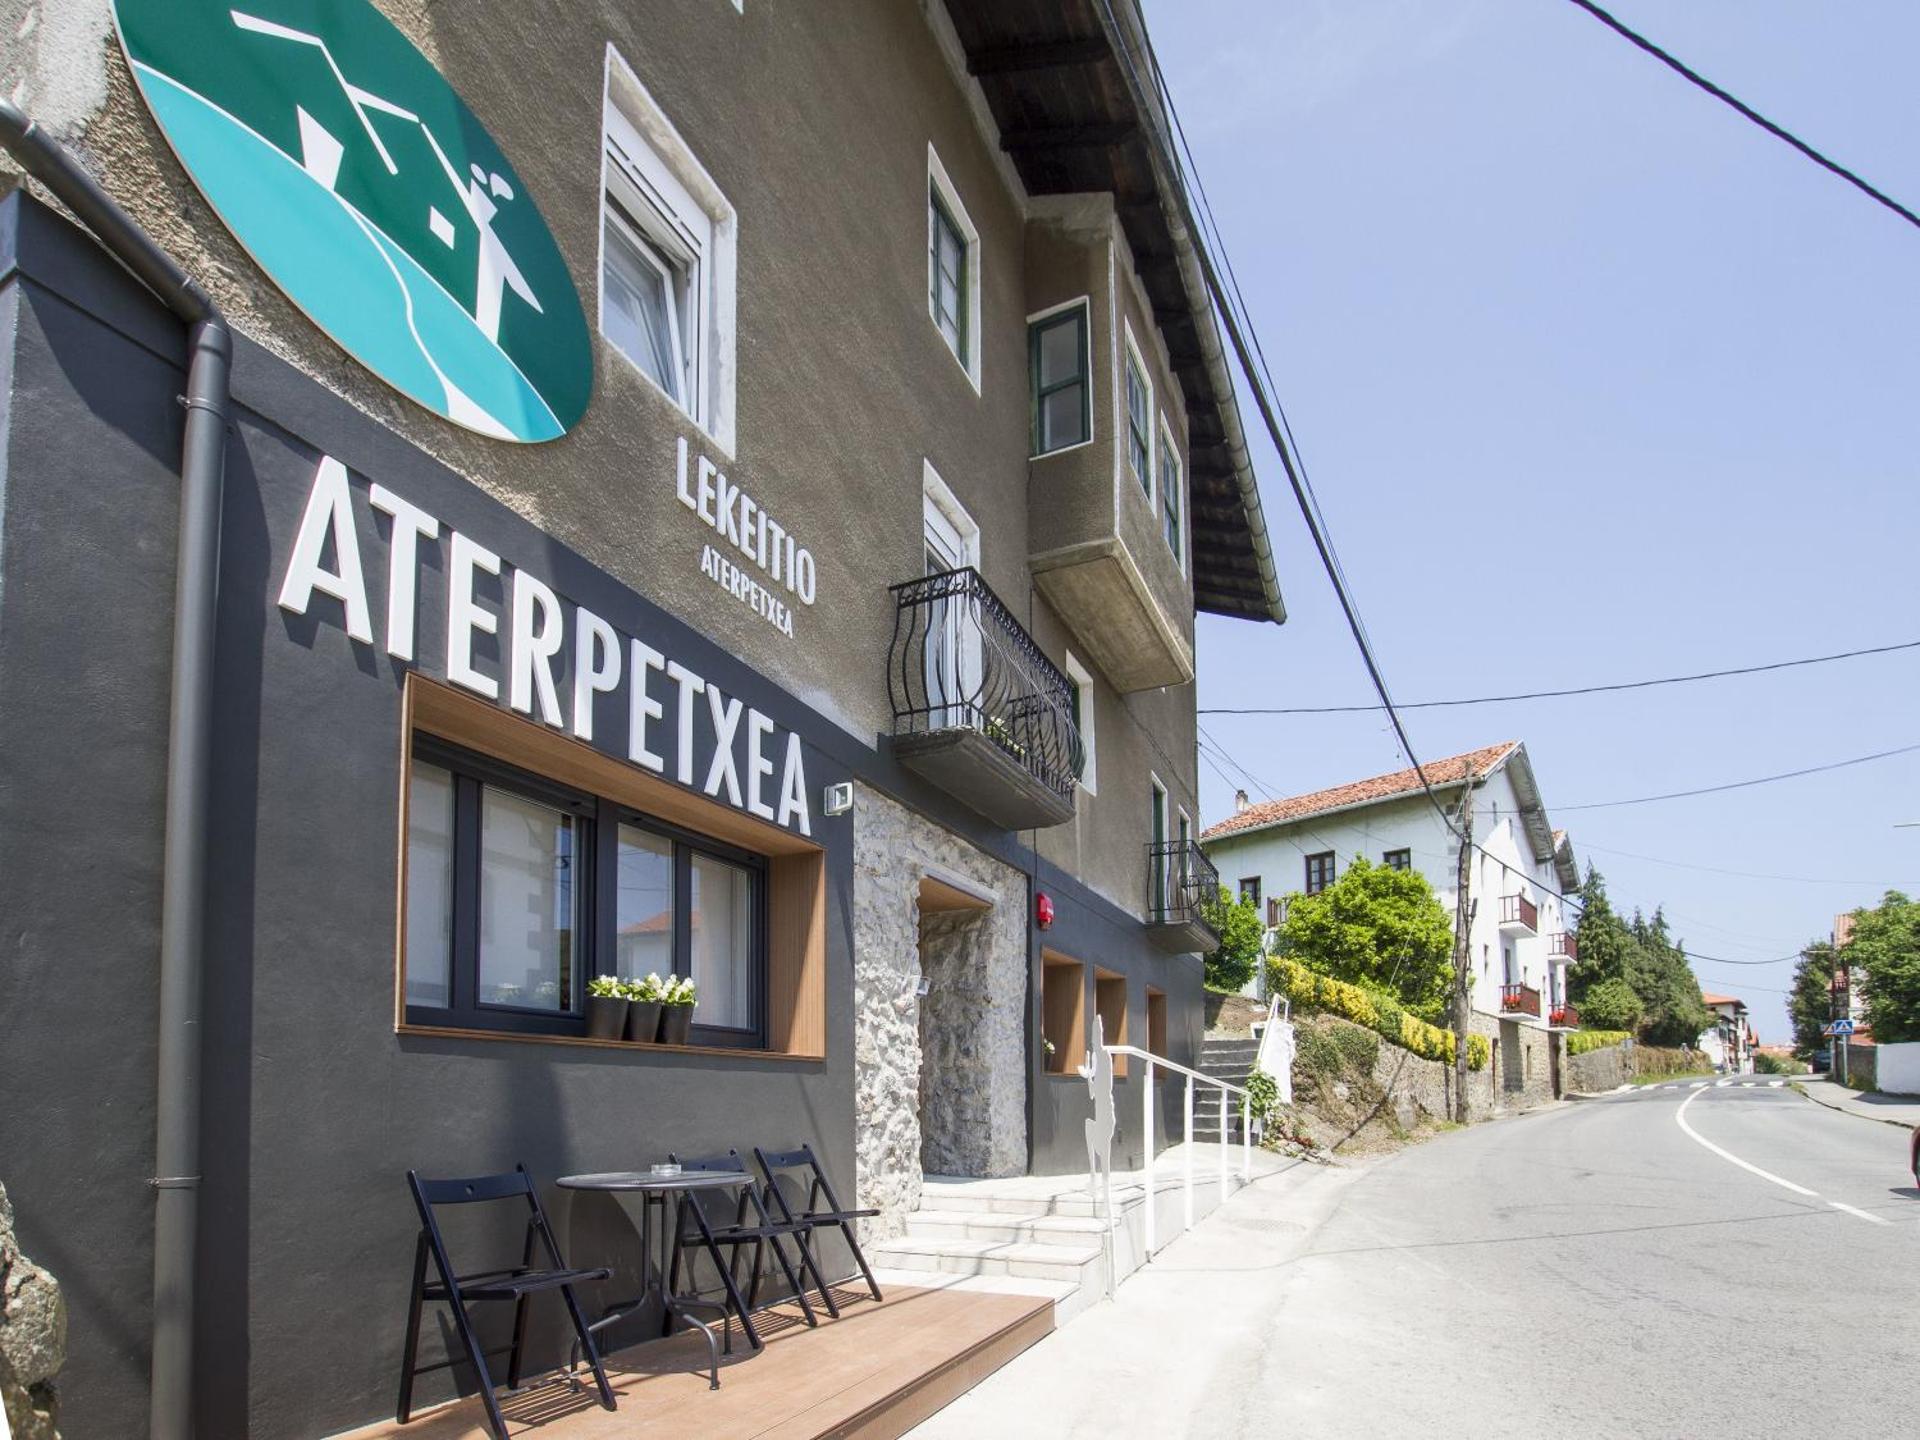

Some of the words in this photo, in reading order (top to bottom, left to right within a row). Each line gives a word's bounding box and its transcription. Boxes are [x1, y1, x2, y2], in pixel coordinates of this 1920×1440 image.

[677, 436, 816, 605] LEKEITIO
[701, 544, 794, 639] ATERPETXEA
[278, 454, 812, 837] ATERPETXEA
